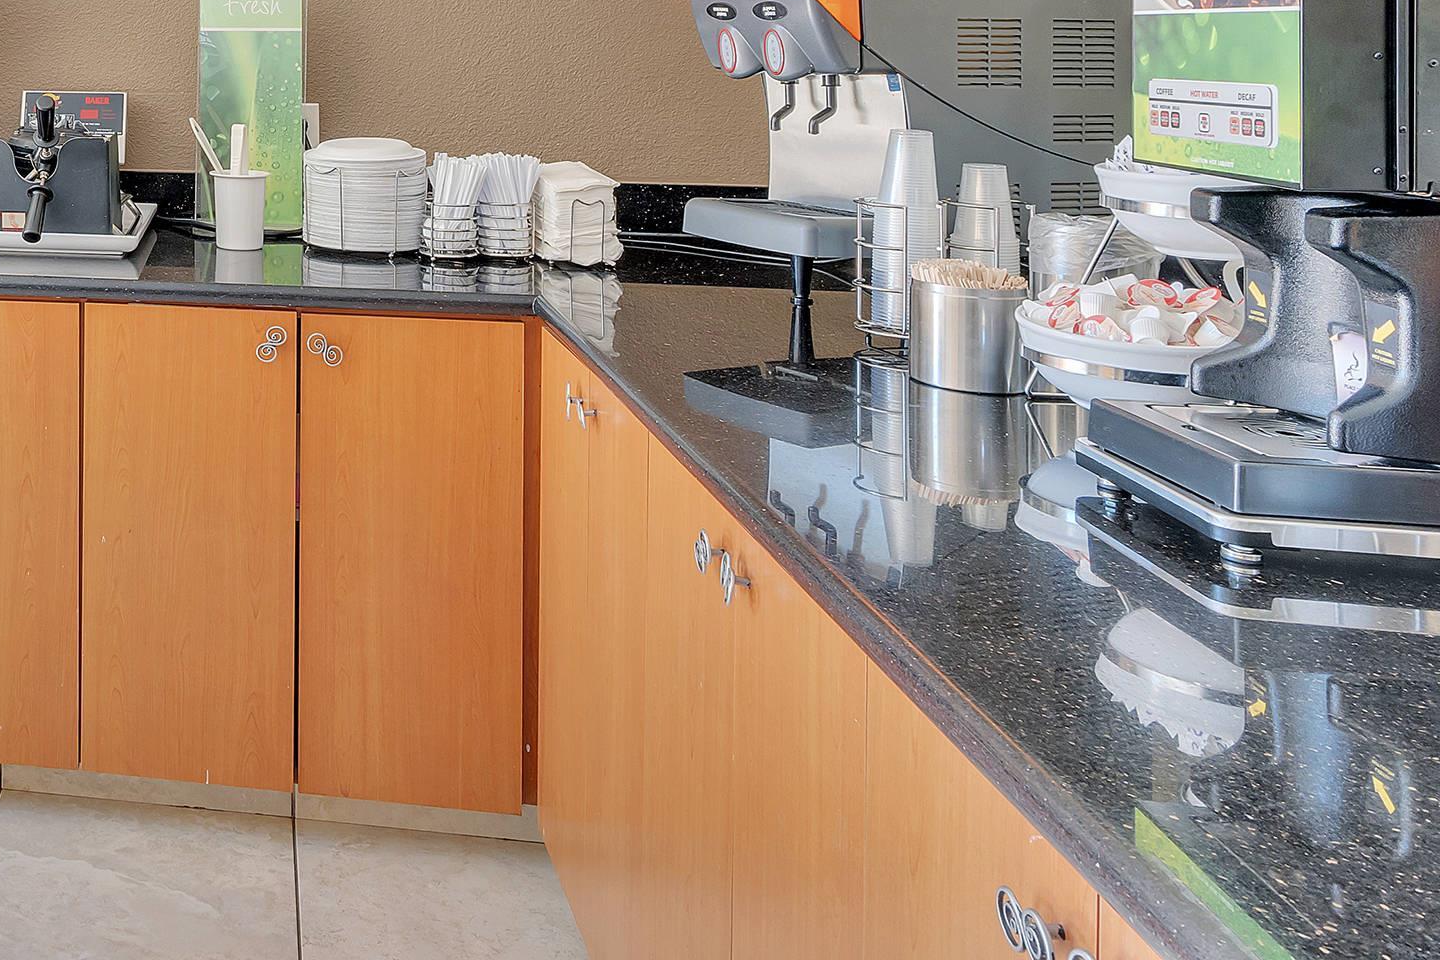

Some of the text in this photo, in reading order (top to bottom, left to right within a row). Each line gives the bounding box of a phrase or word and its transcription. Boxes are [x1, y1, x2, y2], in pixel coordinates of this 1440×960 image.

[1155, 87, 1174, 96] COFFEE
[1201, 91, 1219, 99] WATER
[85, 96, 110, 105] BAKER
[1237, 92, 1257, 101] DECAF
